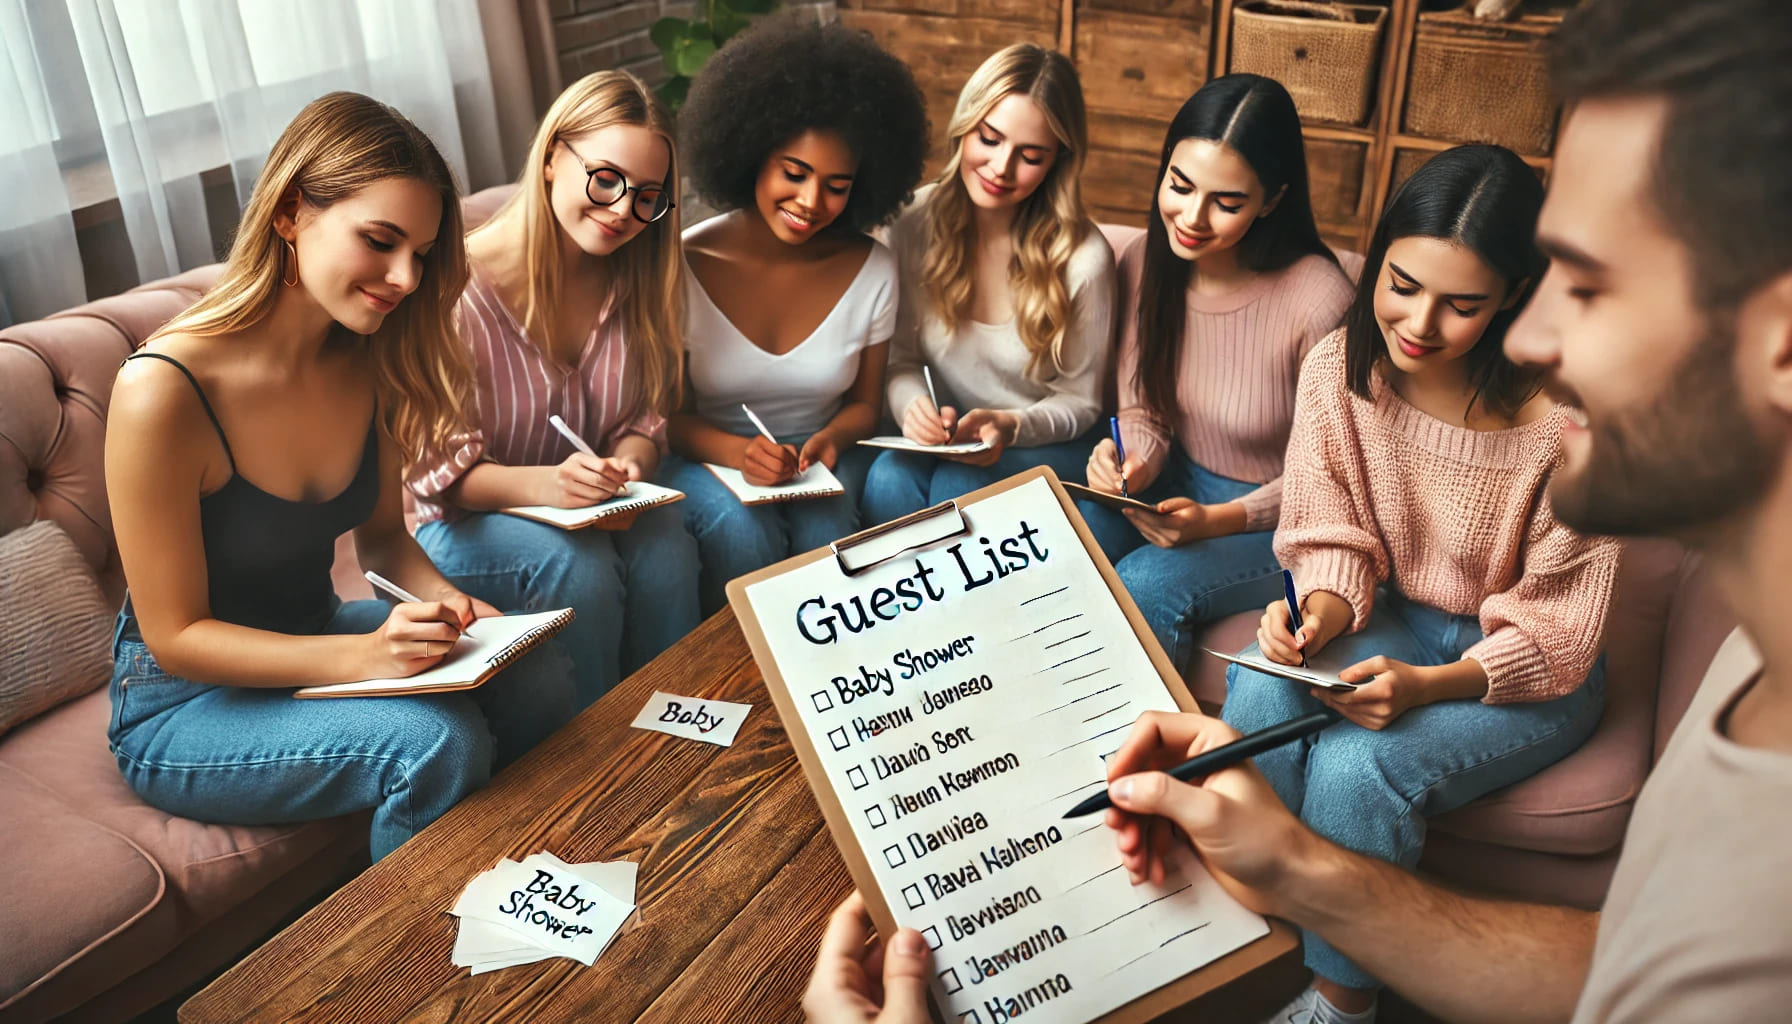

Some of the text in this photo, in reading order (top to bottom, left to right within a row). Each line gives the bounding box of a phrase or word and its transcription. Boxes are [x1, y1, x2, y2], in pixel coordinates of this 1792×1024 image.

[796, 520, 1049, 645] Guest List
[831, 635, 975, 705] Baby Shower
[498, 890, 594, 943] Shower
[525, 869, 597, 917] Baby
